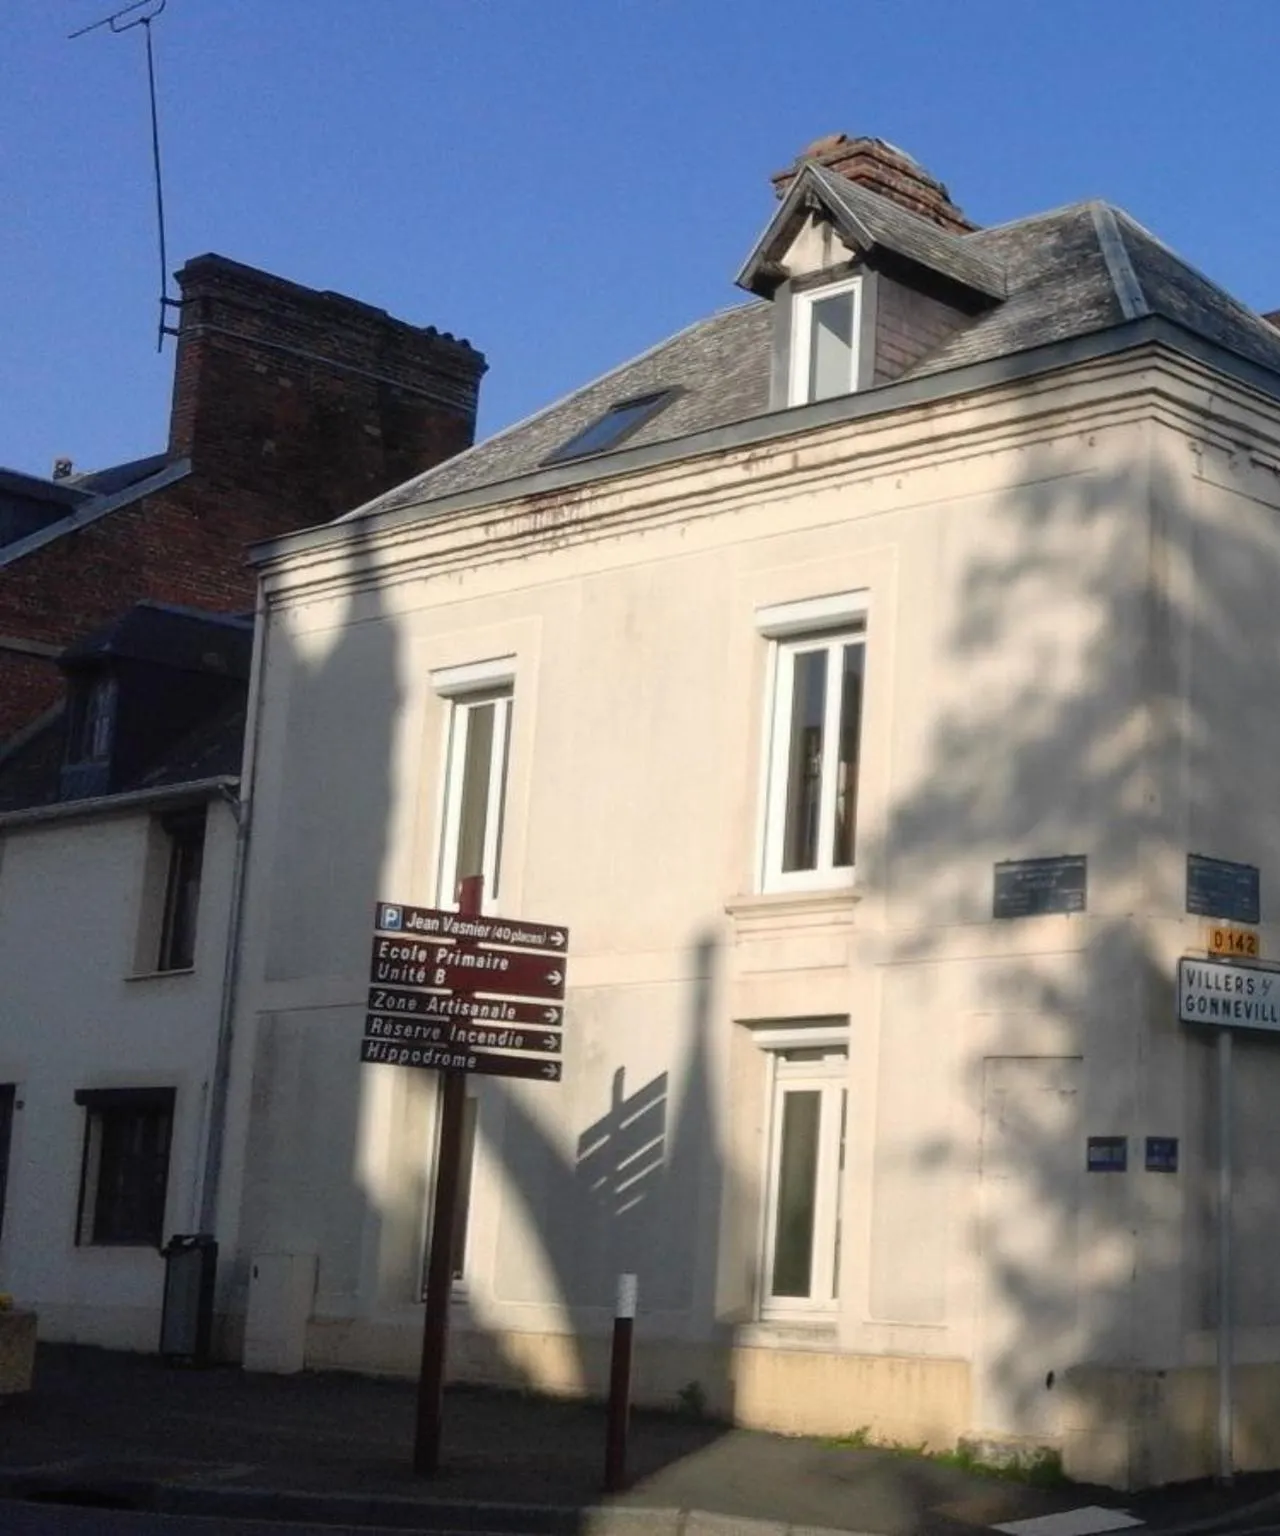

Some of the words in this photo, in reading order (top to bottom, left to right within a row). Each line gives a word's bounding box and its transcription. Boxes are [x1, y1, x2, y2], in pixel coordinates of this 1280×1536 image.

[384, 909, 398, 926] P
[406, 912, 439, 931] Jean
[443, 916, 491, 937] Vasnier
[379, 941, 427, 963] Ecole
[435, 947, 509, 971] Primaire
[377, 963, 426, 983] Unité
[435, 968, 447, 984] B
[1186, 969, 1255, 995] VILLERS
[374, 991, 417, 1011] Zone
[426, 996, 516, 1020] Artisanale
[370, 1017, 441, 1039] Réserve
[450, 1025, 525, 1047] Incendie
[367, 1042, 477, 1069] Hippodrome
